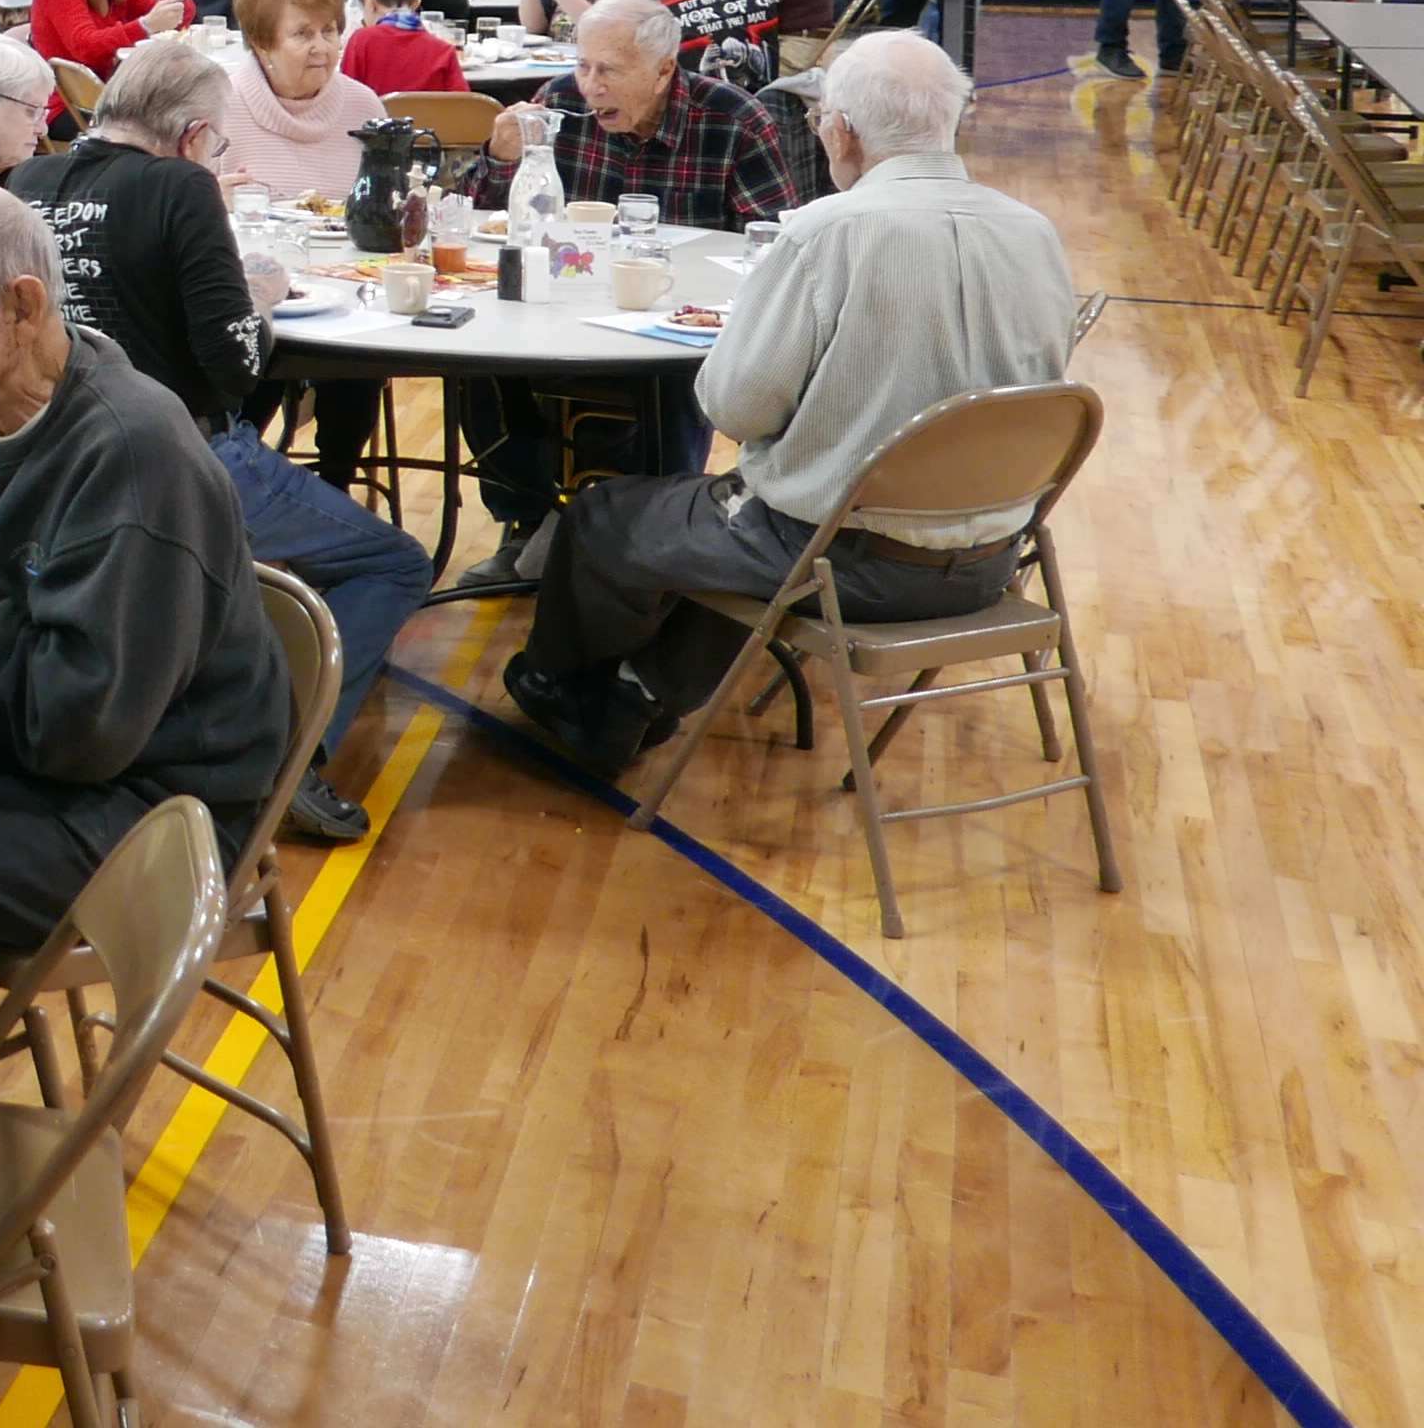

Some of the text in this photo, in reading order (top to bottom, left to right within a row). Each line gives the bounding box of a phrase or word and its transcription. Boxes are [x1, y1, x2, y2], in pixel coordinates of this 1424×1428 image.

[723, 0, 747, 14] OF
[697, 20, 723, 34] THAT
[747, 10, 766, 23] MAY
[28, 200, 108, 225] EEDOM
